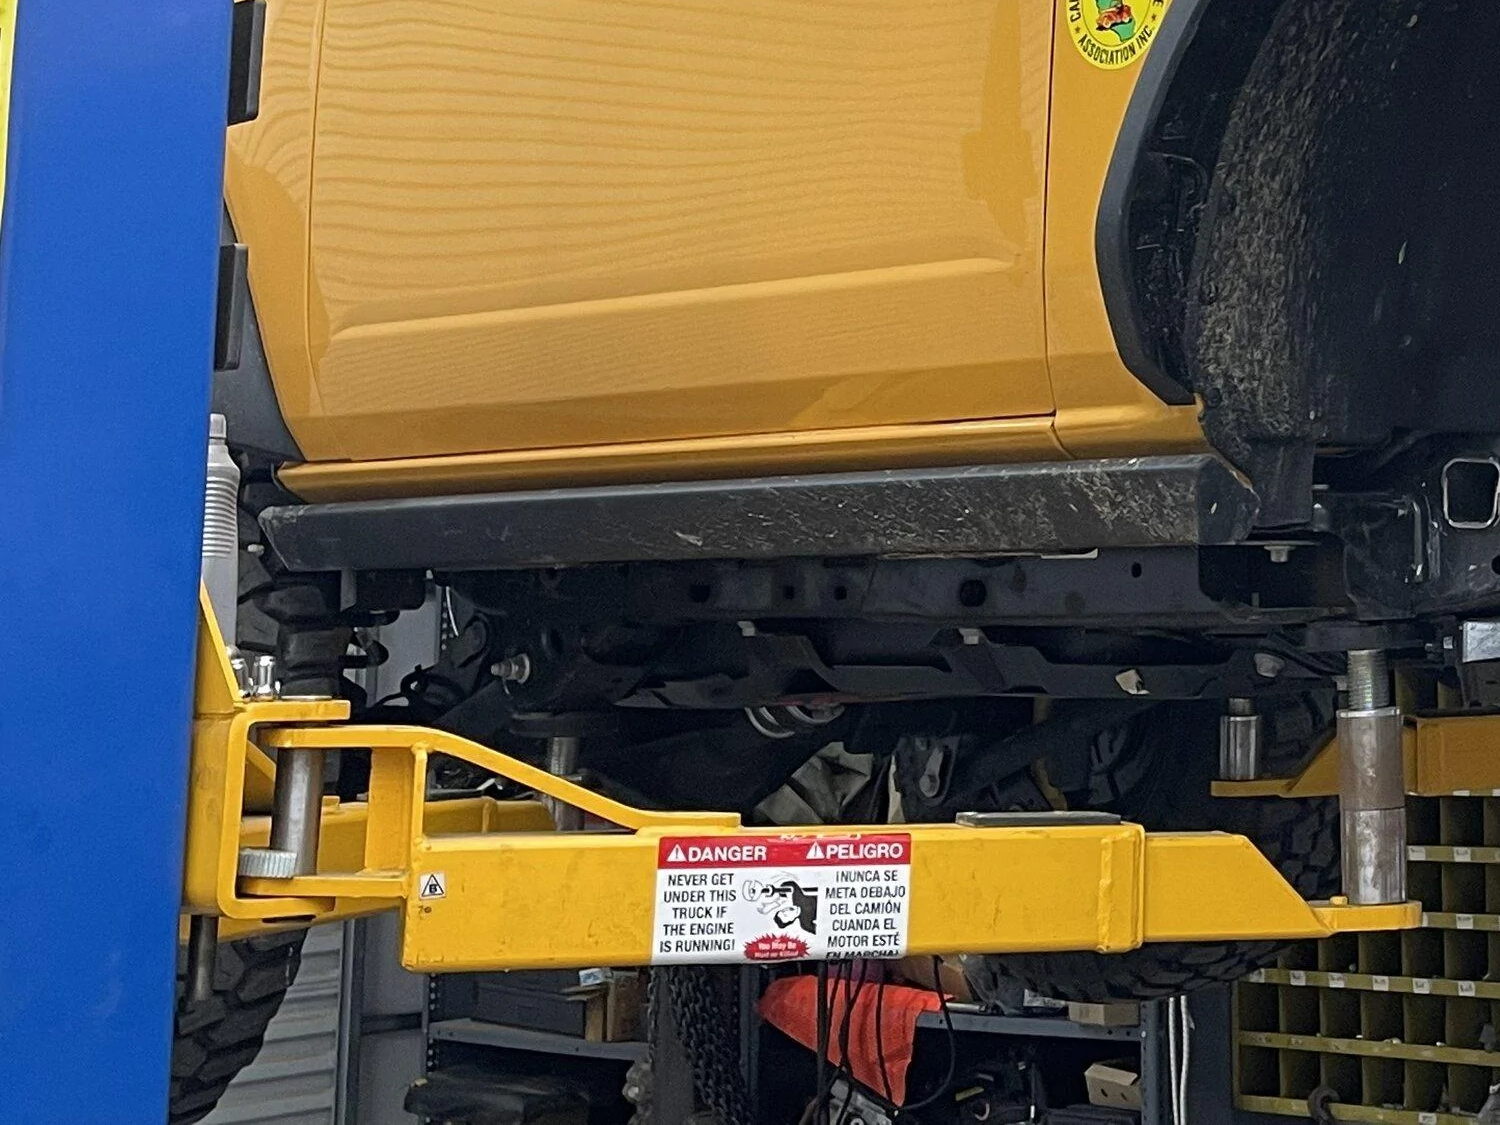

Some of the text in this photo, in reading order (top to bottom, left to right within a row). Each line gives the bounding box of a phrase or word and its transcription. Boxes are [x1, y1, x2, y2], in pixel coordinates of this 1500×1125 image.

[1078, 34, 1136, 64] ASSOCIATION
[688, 845, 767, 862] DANGER
[826, 842, 904, 859] PELIGRO
[668, 873, 734, 887] NEVER GET
[884, 870, 898, 882] SE
[663, 889, 737, 903] UNDER THIS
[825, 885, 906, 899] META DEBAJO
[672, 906, 727, 919] TRUCK IF
[830, 900, 901, 915] DEL CAMIÓN
[663, 922, 734, 936] THE ENGINE
[832, 918, 897, 931] CUANDA EL
[660, 939, 735, 952] IS RUNNING!
[827, 932, 900, 948] MOTOR ESTÉ
